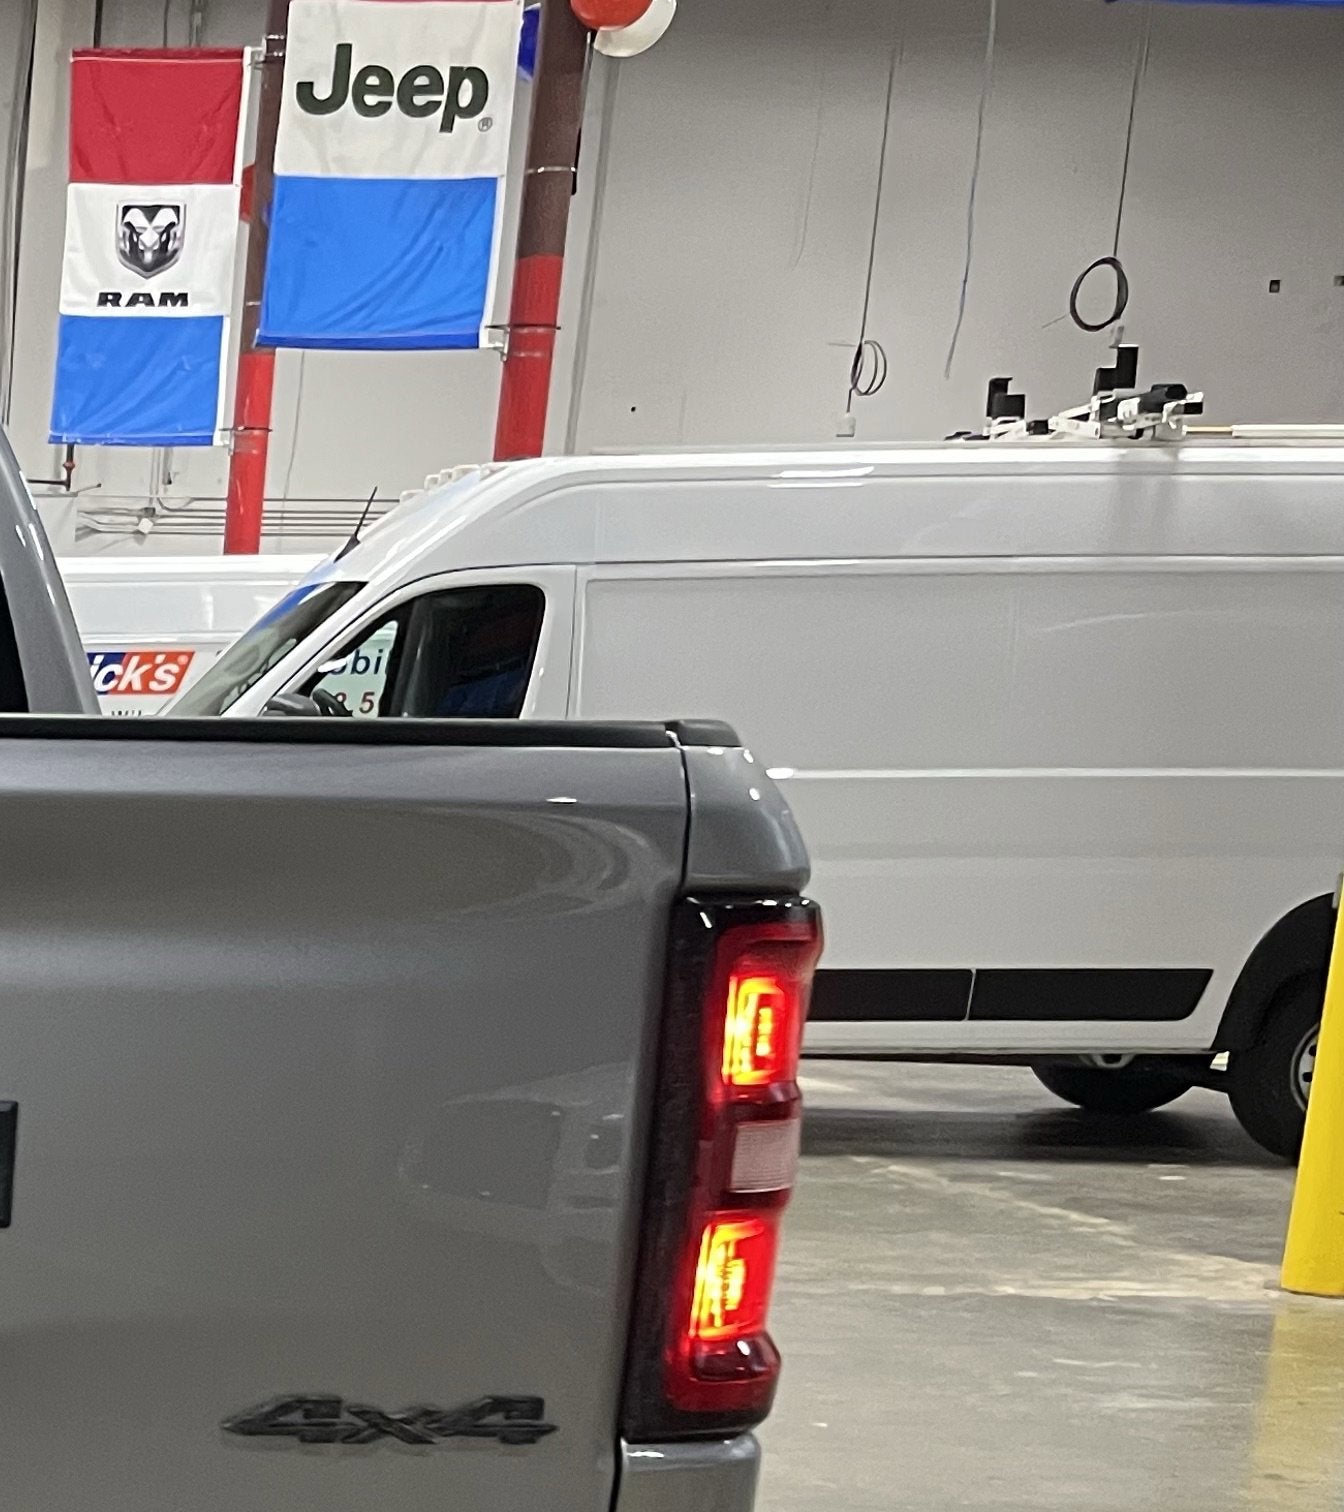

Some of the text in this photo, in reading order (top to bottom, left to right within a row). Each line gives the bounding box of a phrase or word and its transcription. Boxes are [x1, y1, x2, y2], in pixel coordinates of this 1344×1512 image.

[295, 43, 490, 133] Jeep
[96, 291, 189, 308] RAM
[89, 654, 180, 691] ick's
